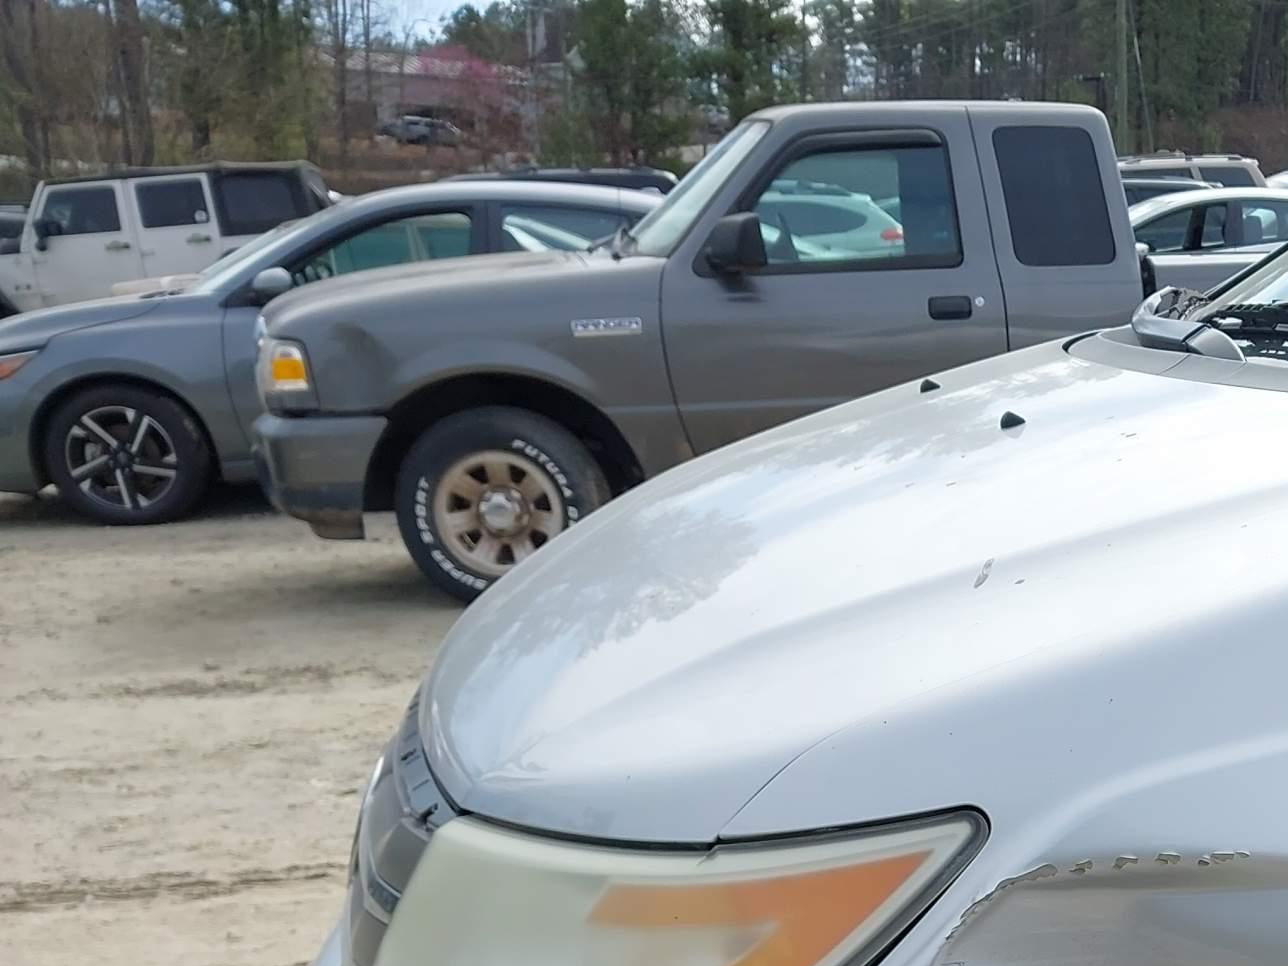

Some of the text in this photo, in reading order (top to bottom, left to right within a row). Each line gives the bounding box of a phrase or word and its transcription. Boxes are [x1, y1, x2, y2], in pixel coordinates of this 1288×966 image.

[511, 438, 574, 498] FUTURA
[414, 476, 488, 591] SUPER SPORT
